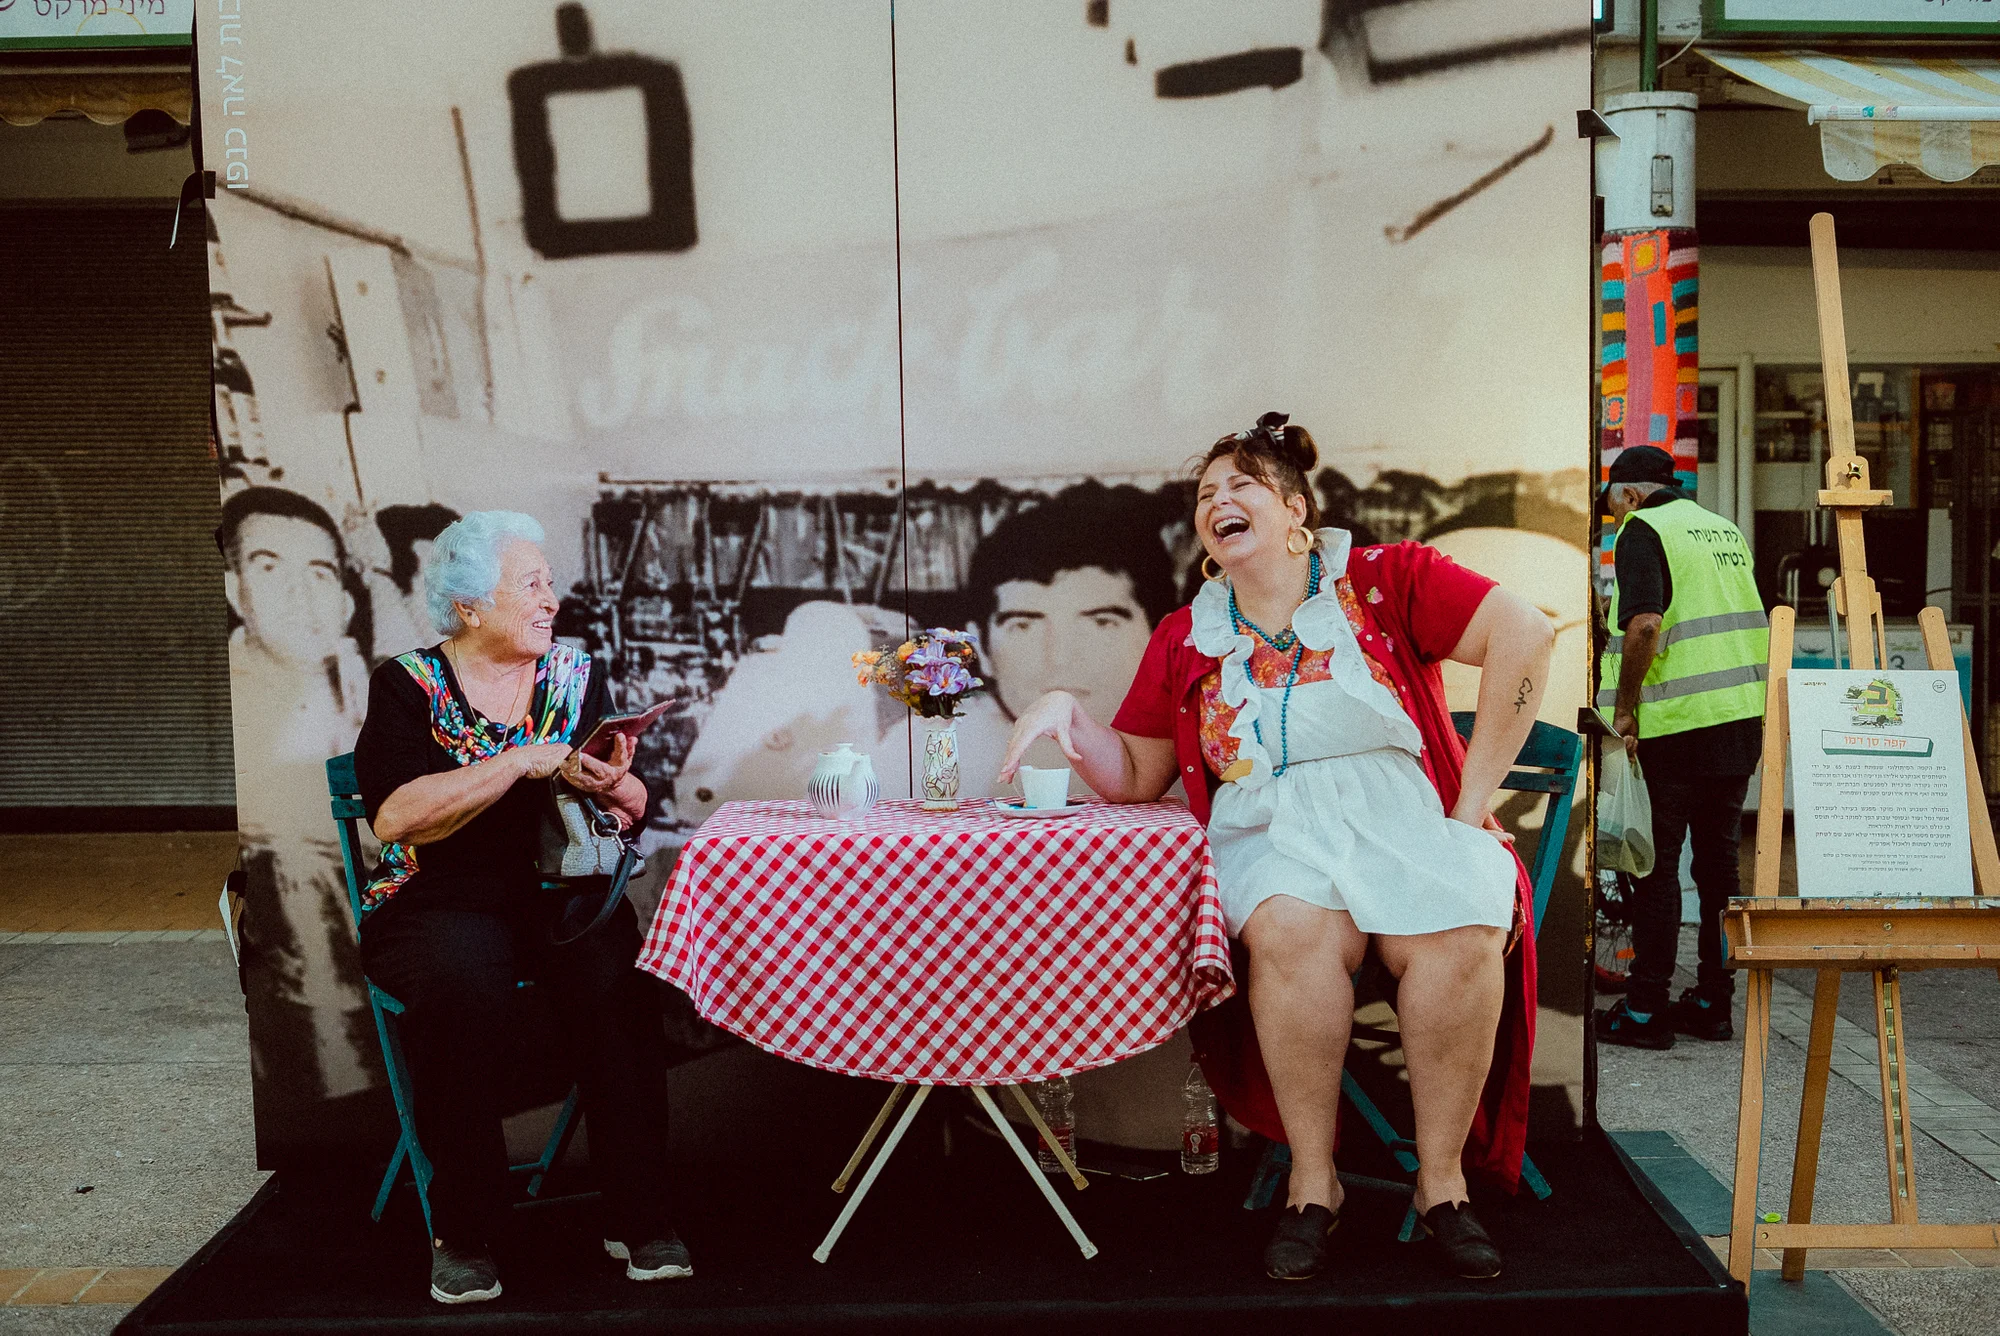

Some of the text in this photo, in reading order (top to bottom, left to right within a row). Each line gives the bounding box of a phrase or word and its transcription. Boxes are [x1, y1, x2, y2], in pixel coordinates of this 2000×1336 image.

[216, 55, 245, 116] לאה
[225, 127, 249, 189] כנפו
[1687, 528, 1722, 543] השחר
[1713, 552, 1746, 570] בטחון
[1844, 735, 1907, 750] קפה סן רמו
